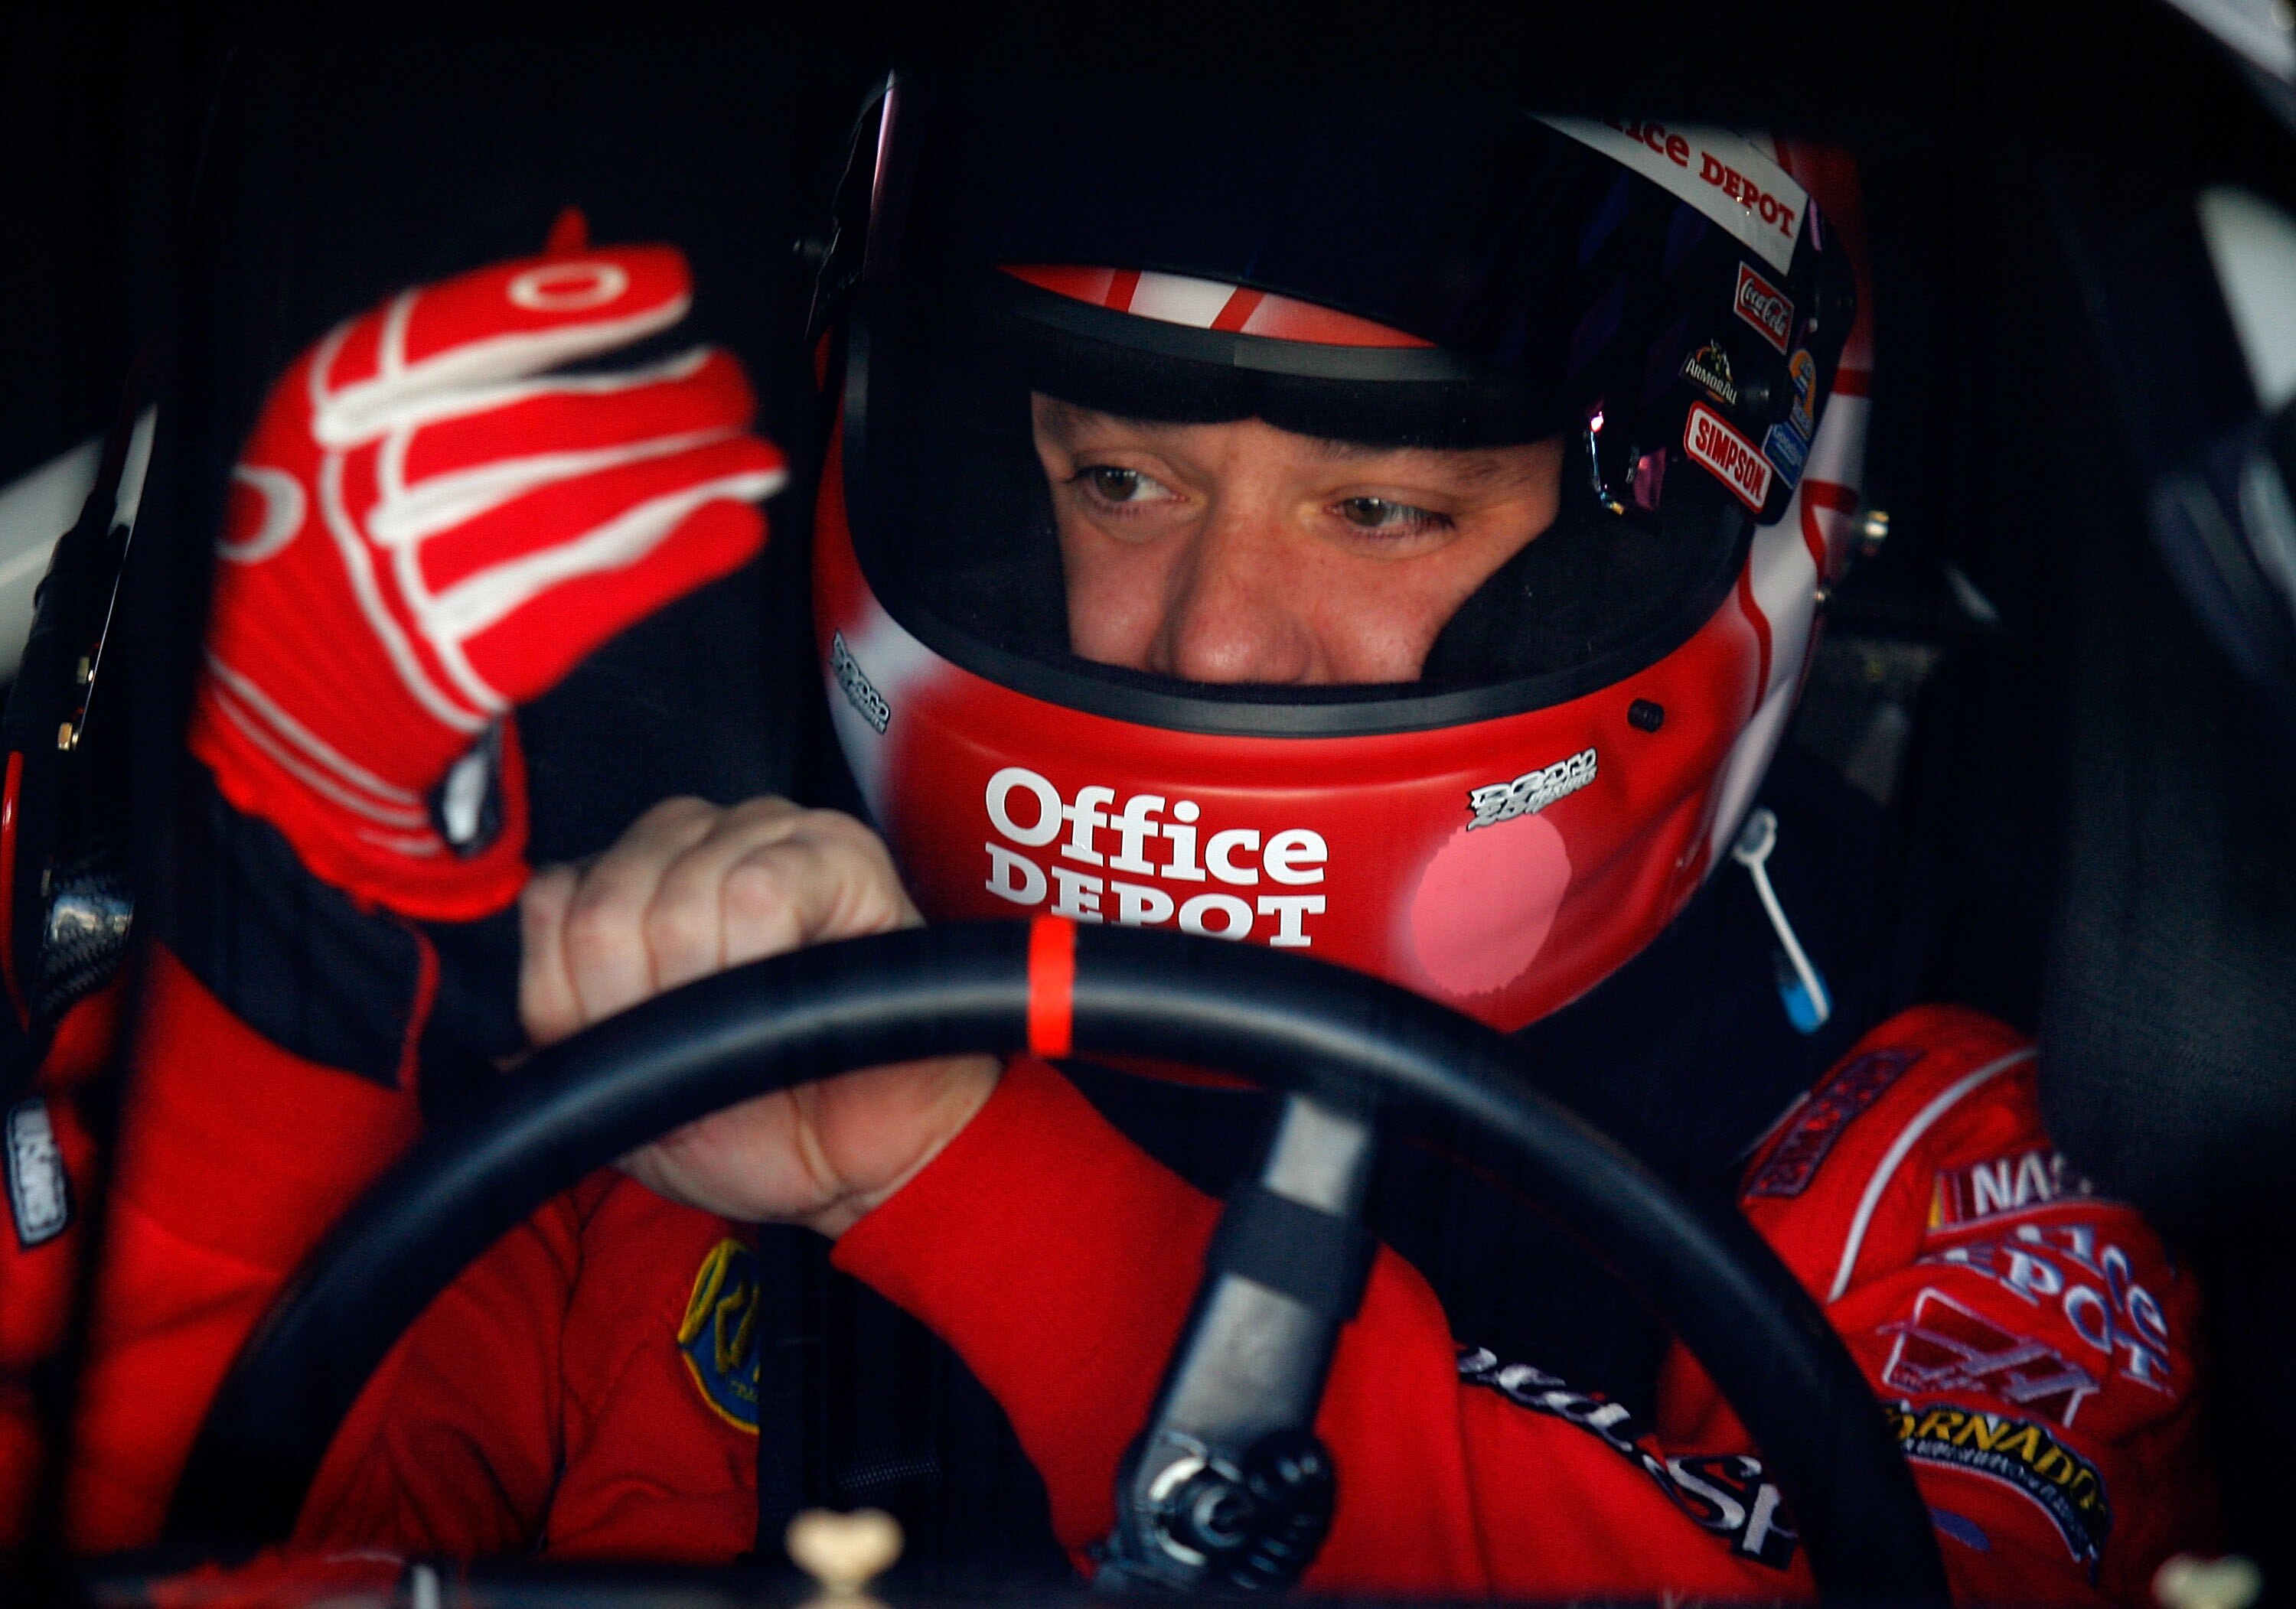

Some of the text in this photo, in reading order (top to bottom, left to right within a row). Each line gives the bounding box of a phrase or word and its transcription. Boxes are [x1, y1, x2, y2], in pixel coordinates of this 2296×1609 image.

[1699, 151, 1795, 238] DEPOT
[1695, 416, 1766, 499] SIMPSON
[985, 767, 1329, 886] Office
[985, 842, 1326, 947] DEPOT
